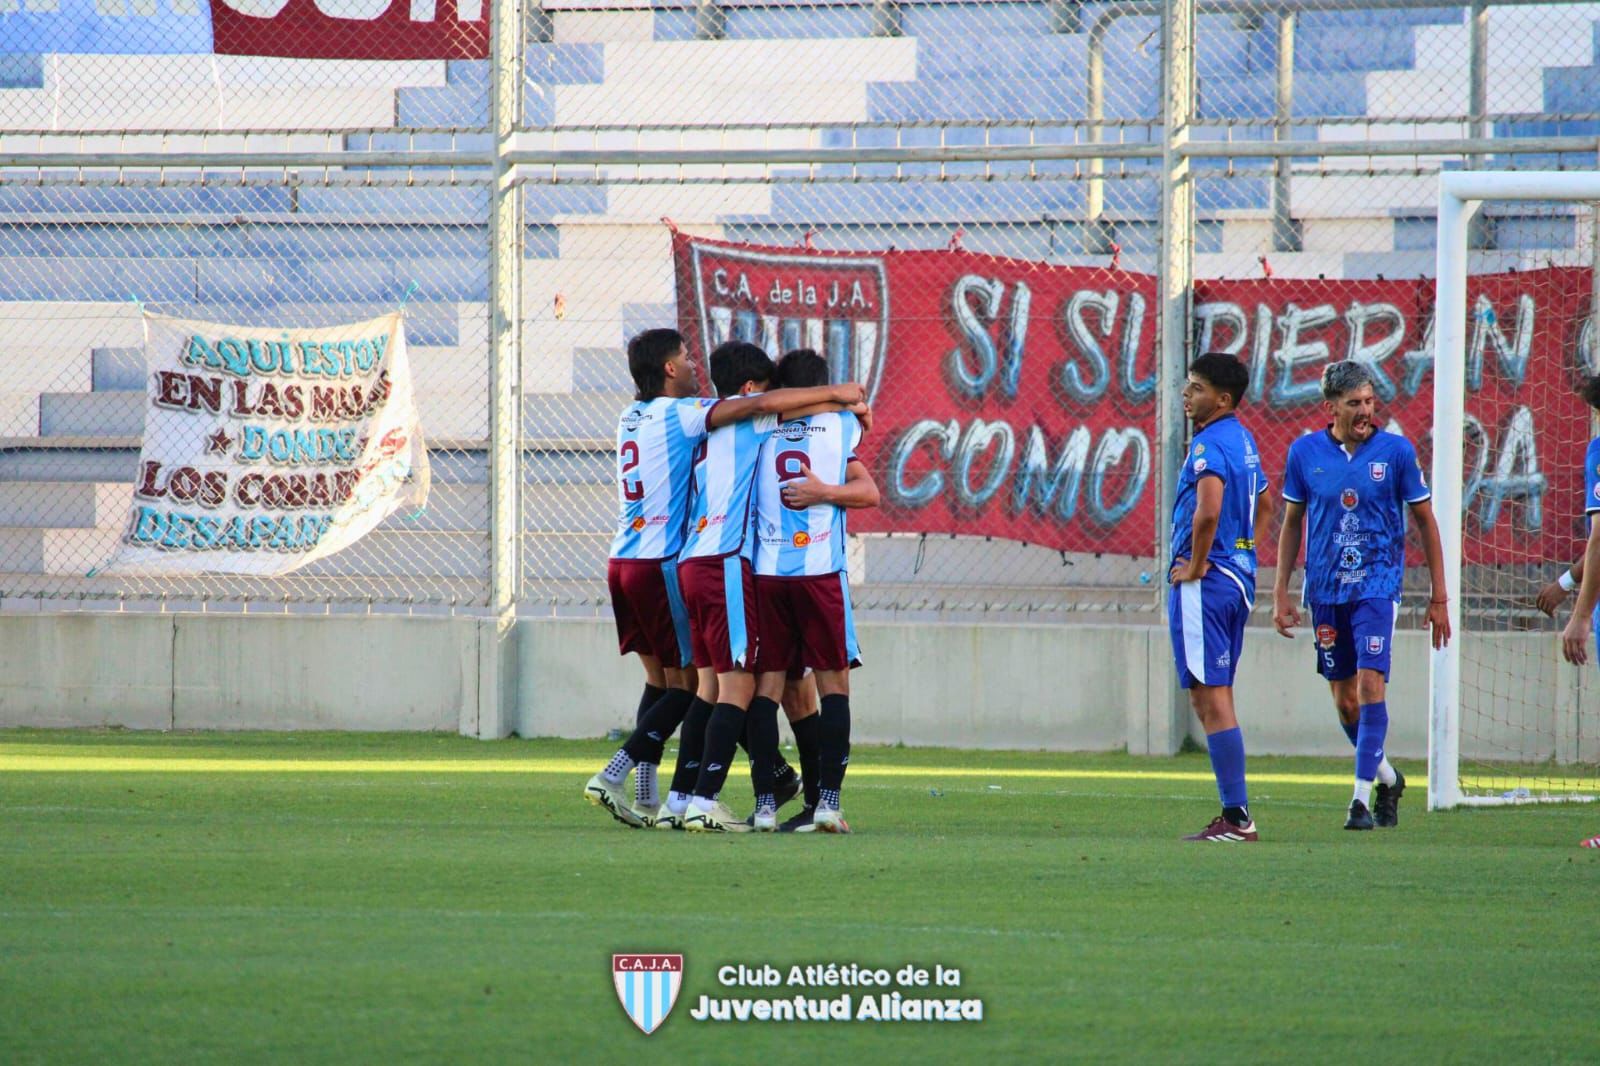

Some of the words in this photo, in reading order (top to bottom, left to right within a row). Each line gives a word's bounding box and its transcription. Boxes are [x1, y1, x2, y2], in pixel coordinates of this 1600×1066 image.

[714, 268, 760, 302] C.A.
[769, 277, 793, 304] de
[798, 279, 817, 305] la
[827, 279, 873, 308] J.A.
[300, 334, 388, 378] ESTOY
[950, 273, 1031, 400] SI
[155, 371, 223, 413] EN
[232, 378, 304, 420] LAS
[138, 460, 228, 508] LOS
[620, 440, 645, 501] 2
[890, 416, 1150, 528] COMO
[1324, 651, 1336, 668] 5
